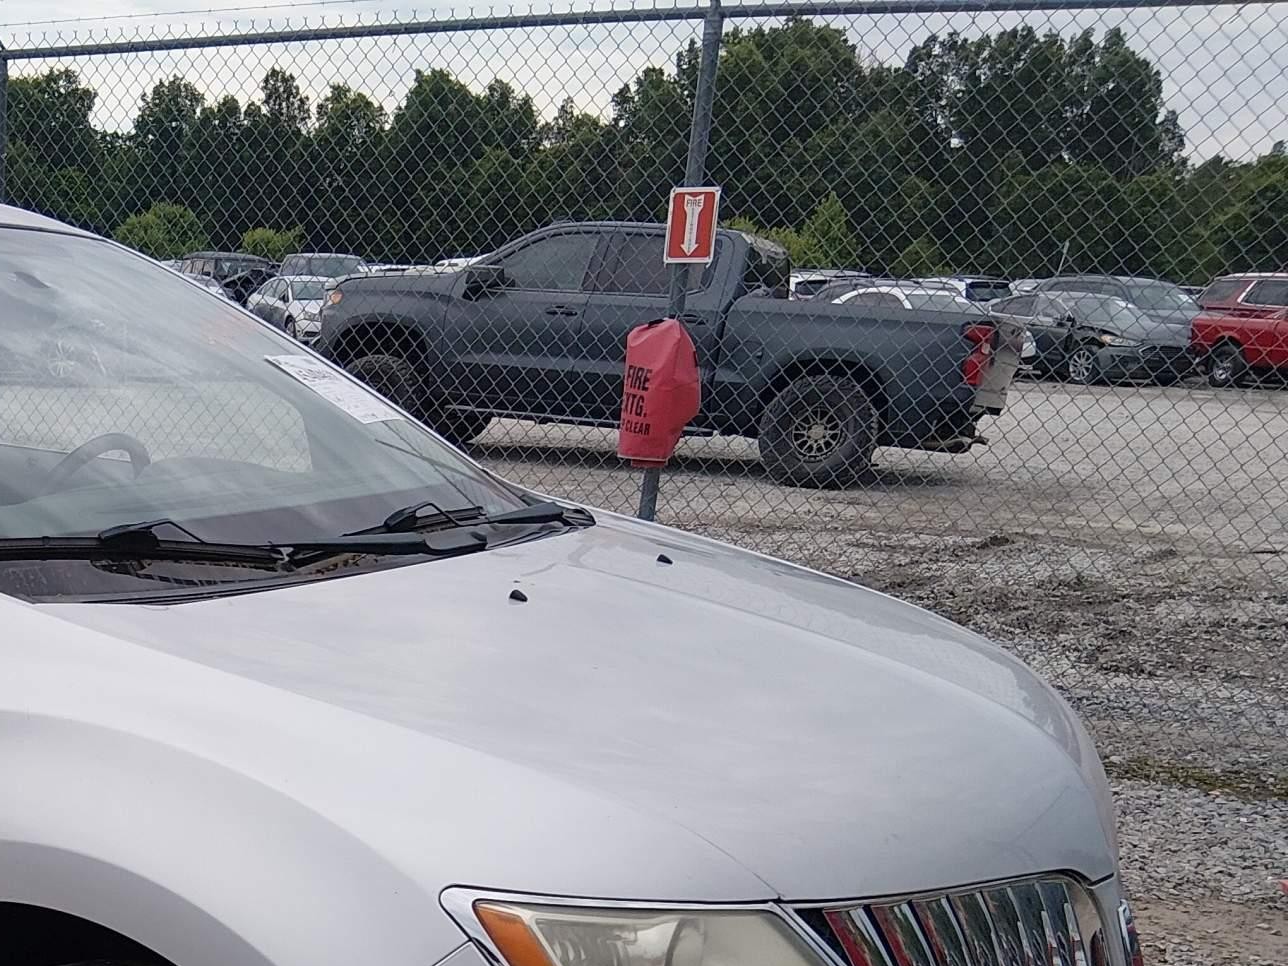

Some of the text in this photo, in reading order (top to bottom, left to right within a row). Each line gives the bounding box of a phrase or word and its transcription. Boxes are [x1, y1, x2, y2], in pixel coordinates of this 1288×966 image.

[686, 199, 703, 208] FIRE
[626, 365, 653, 391] FIRE
[623, 392, 647, 418] XTG.
[625, 419, 651, 436] CLEAR
